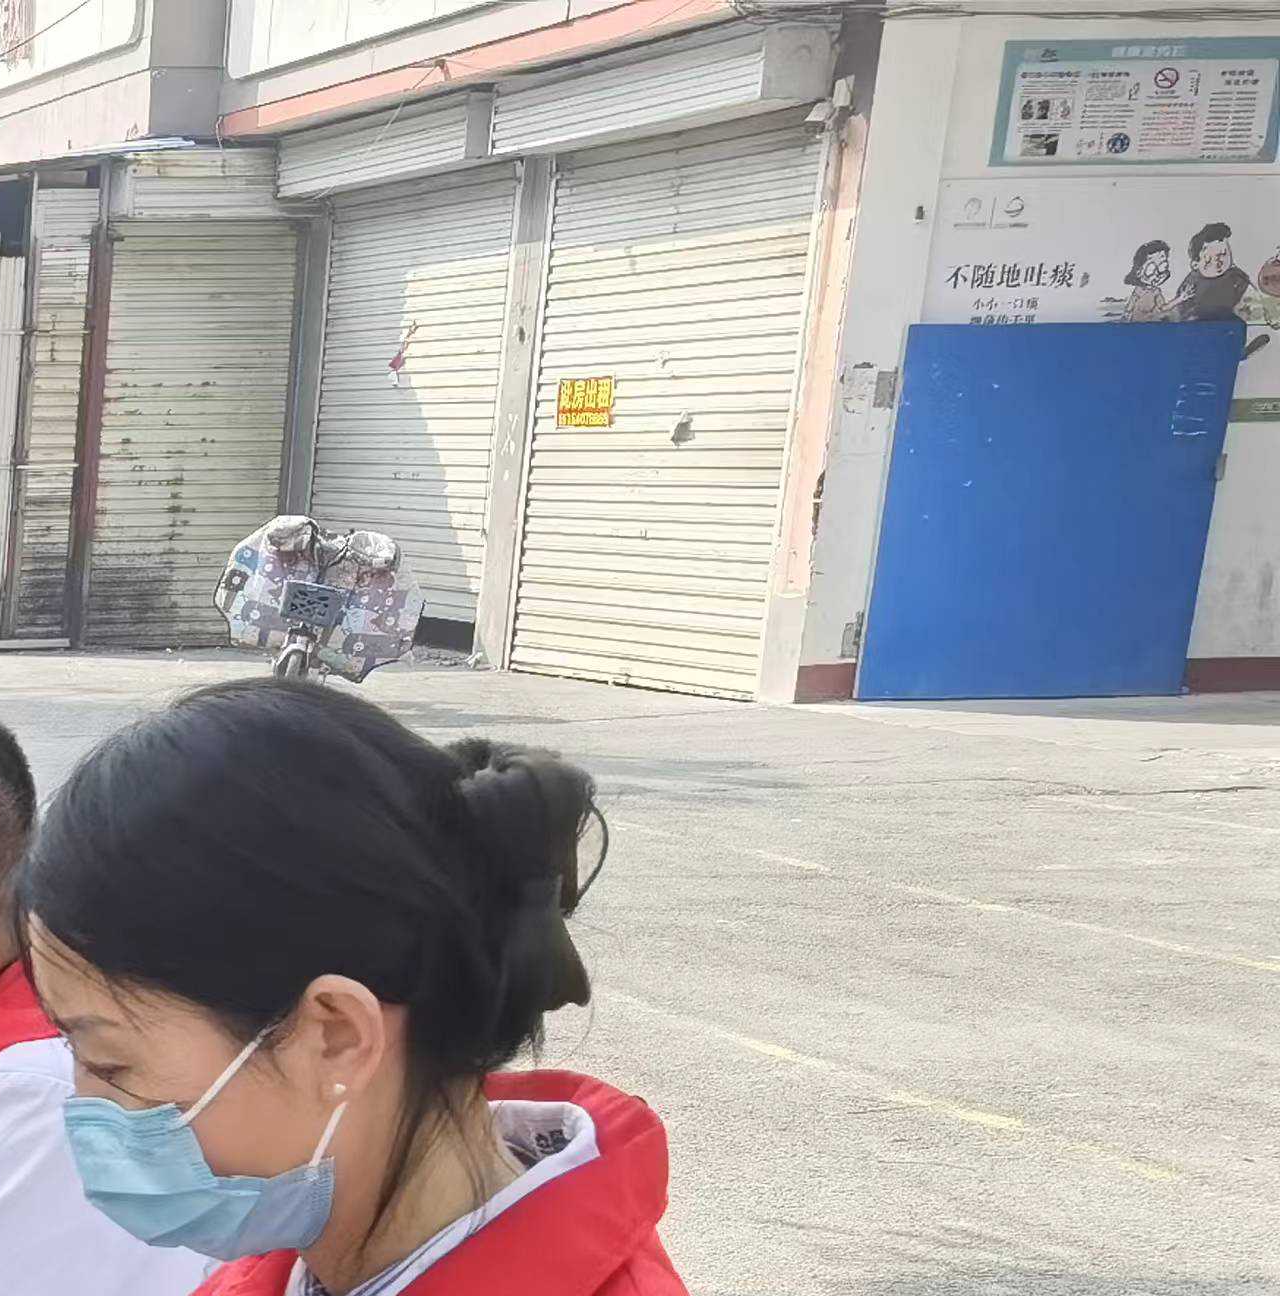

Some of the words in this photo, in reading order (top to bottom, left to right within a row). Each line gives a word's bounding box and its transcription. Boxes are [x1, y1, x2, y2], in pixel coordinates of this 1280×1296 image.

[945, 261, 1076, 289] 不随地吐痰
